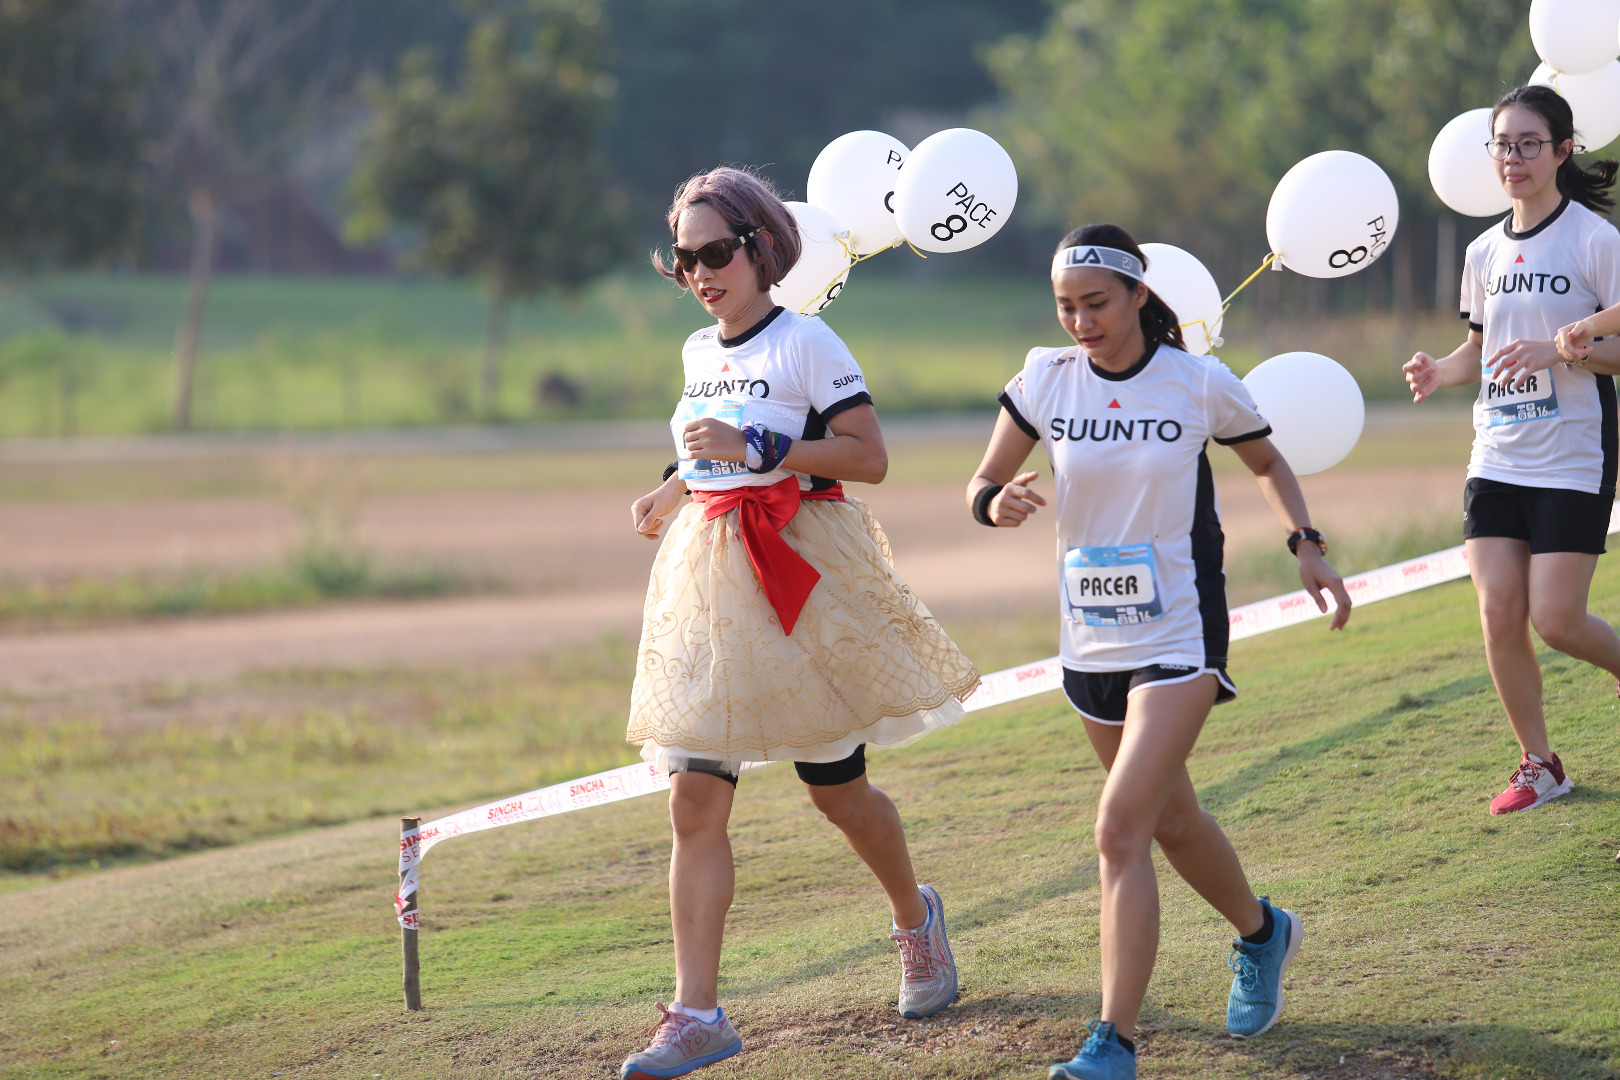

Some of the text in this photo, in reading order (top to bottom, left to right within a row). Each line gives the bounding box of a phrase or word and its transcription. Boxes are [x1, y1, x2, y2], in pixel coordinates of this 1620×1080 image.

[946, 181, 997, 229] PACE
[930, 214, 968, 242] 8
[1328, 245, 1368, 269] 8
[1536, 405, 1549, 418] 16
[1051, 417, 1183, 443] SUUNTO
[1080, 575, 1138, 597] PACER
[570, 779, 605, 797] SINGHA
[487, 800, 523, 820] SINGHA
[400, 827, 441, 851] SINGHA
